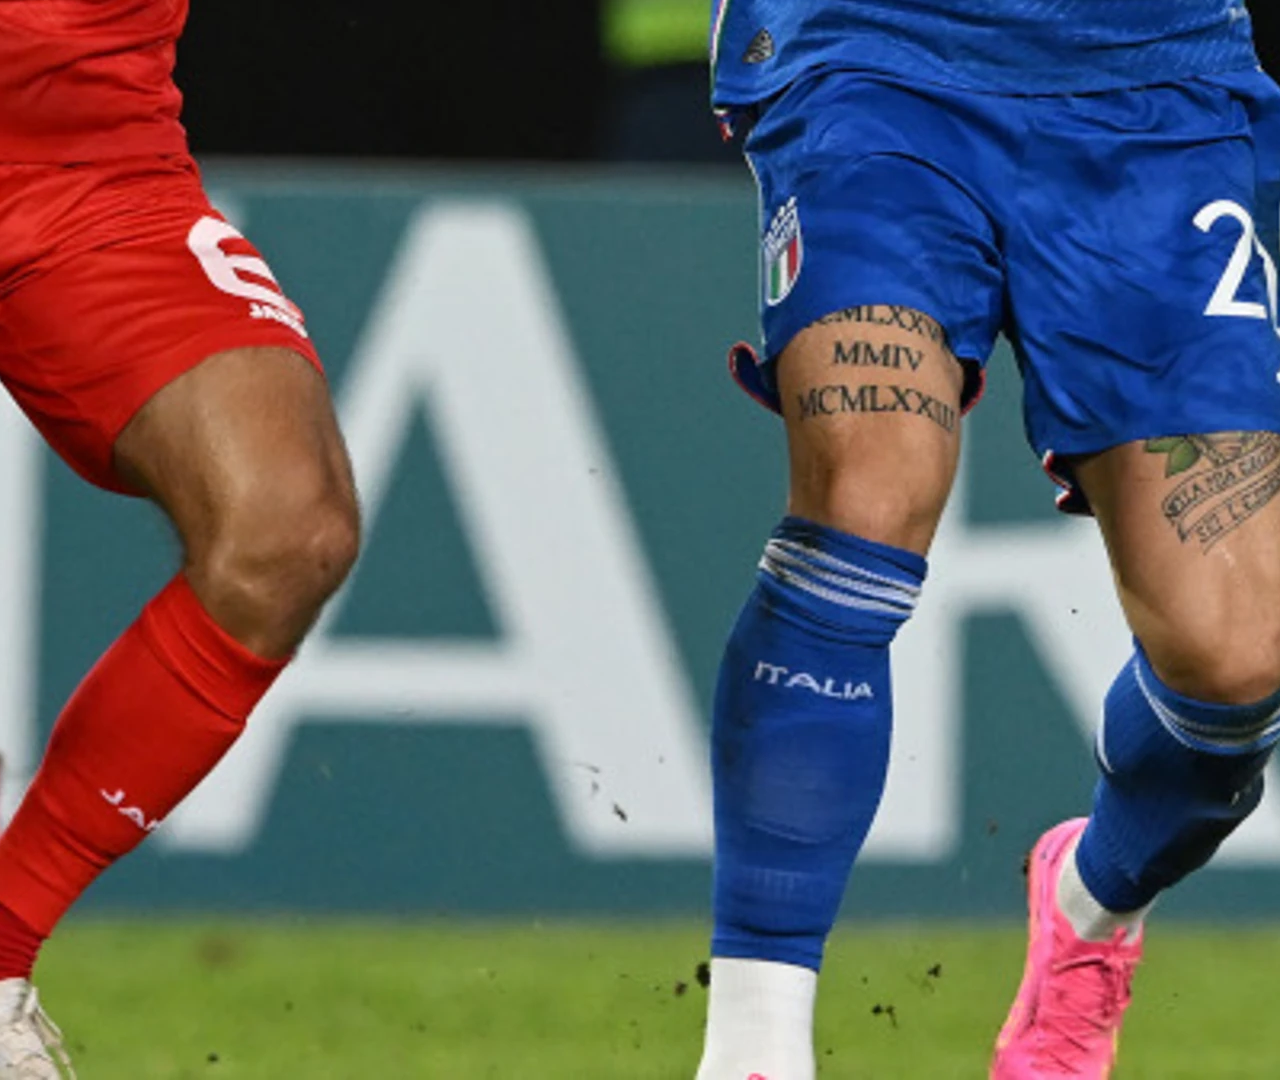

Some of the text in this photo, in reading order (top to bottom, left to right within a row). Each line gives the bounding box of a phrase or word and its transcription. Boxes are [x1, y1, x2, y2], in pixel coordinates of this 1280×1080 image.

[186, 215, 306, 325] 6
[832, 340, 925, 371] MMIV
[753, 659, 875, 700] ITALIA
